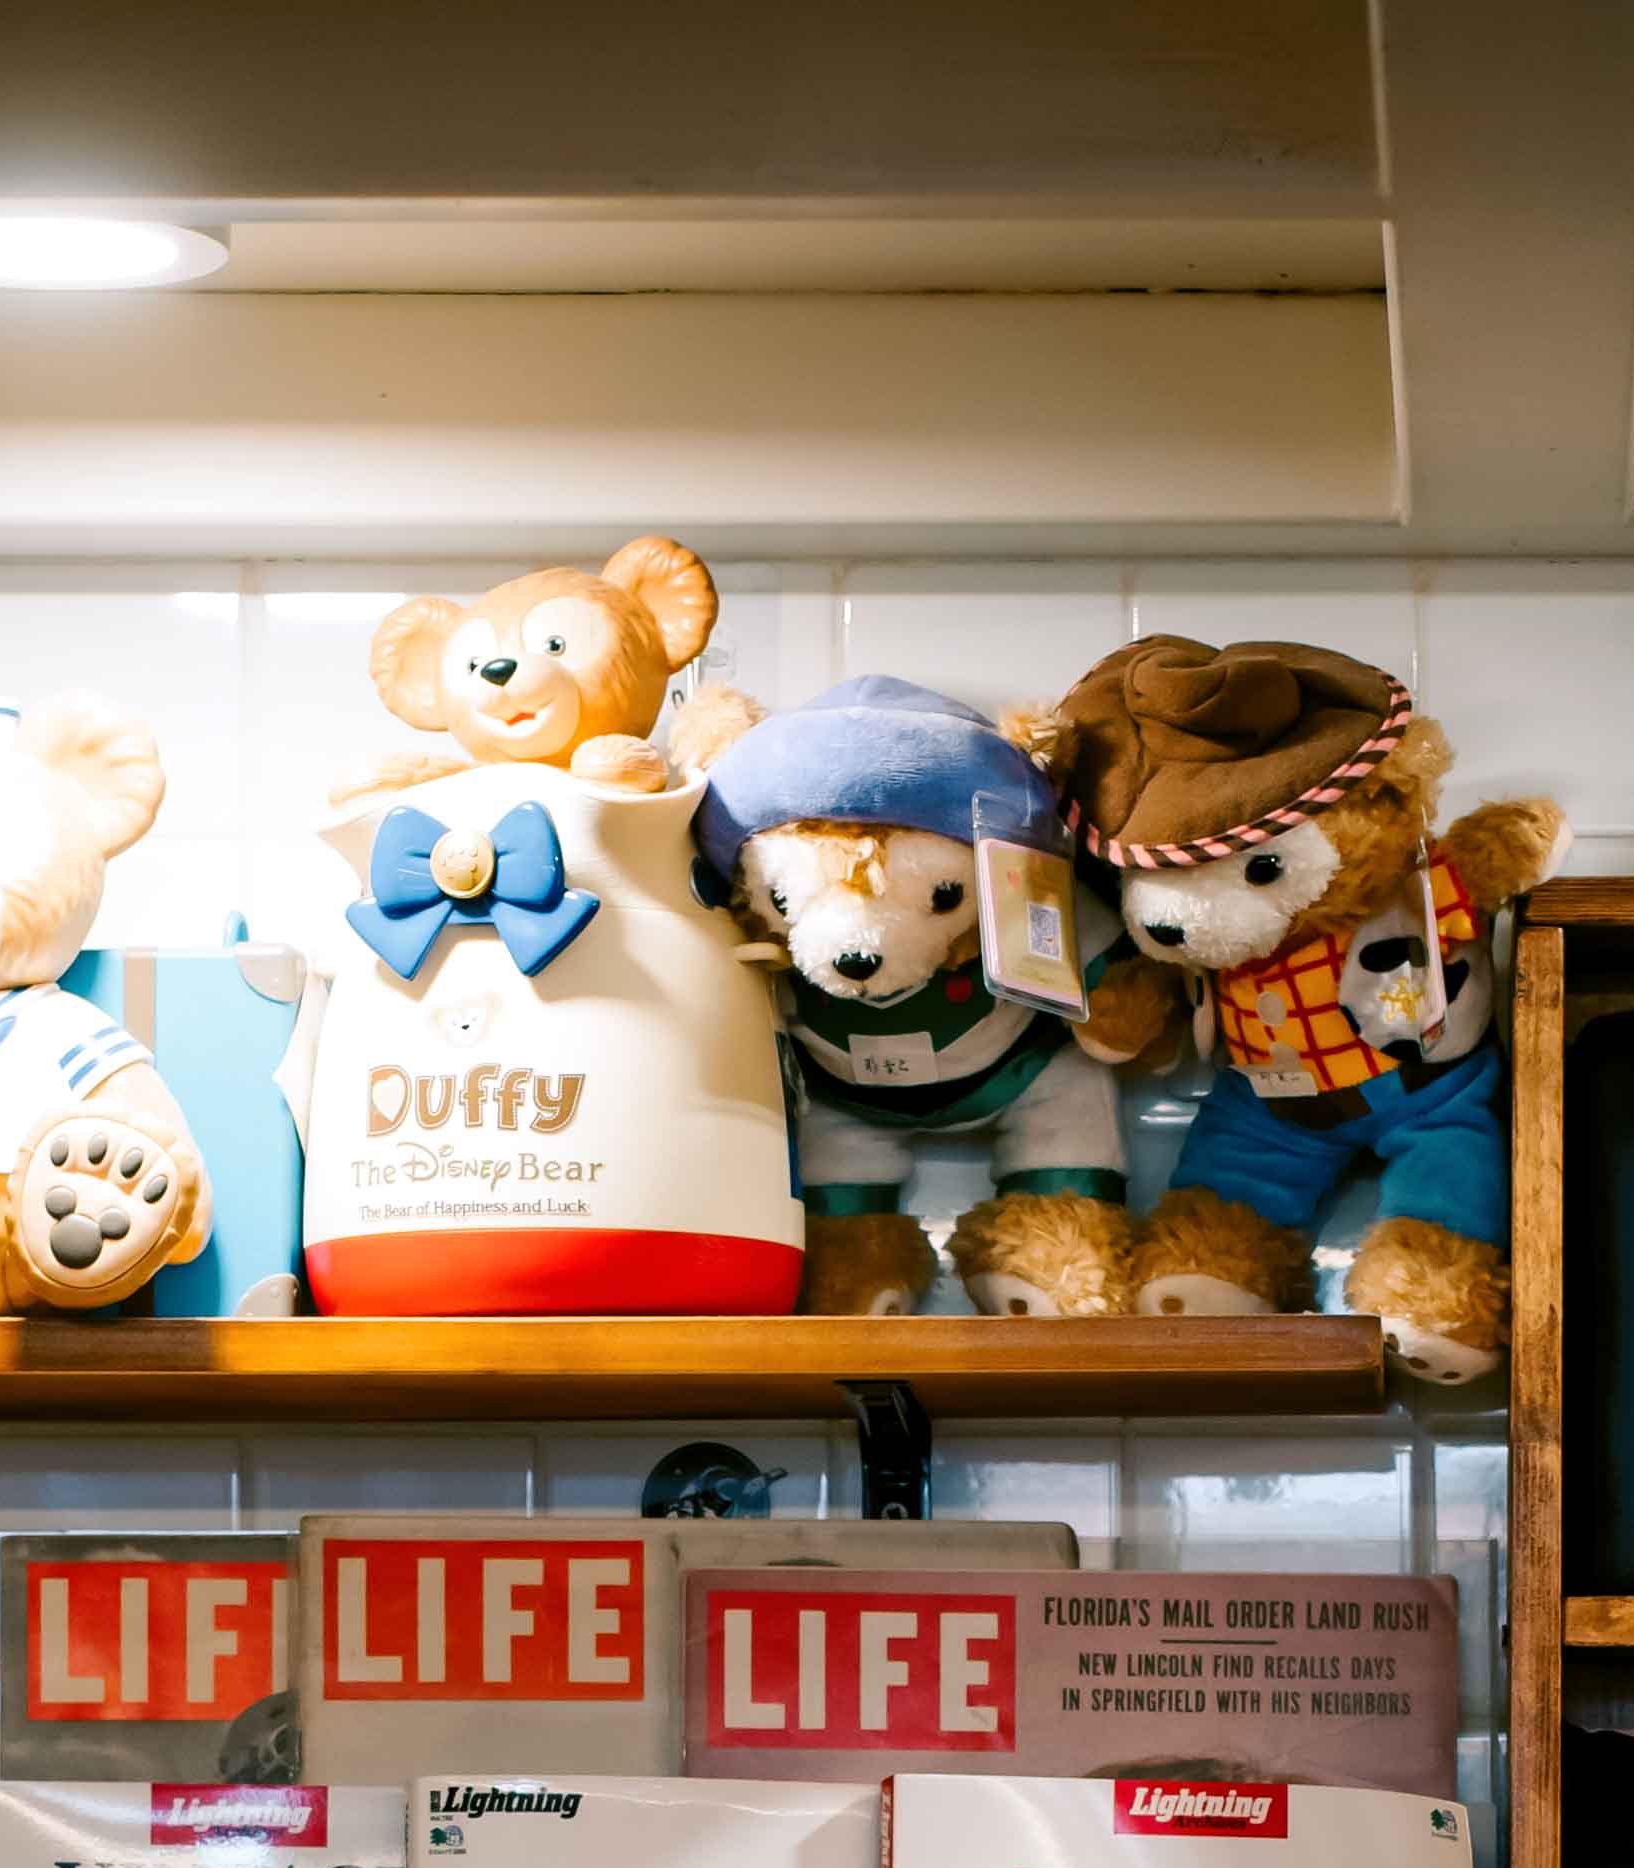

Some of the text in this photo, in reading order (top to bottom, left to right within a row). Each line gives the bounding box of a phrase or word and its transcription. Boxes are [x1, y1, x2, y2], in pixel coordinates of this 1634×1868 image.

[366, 1063, 586, 1137] Duffy
[350, 1141, 605, 1193] The Disney Bear
[359, 1197, 590, 1221] The Bear of Happiness and Luck
[338, 1558, 630, 1682] LIFE
[1043, 1596, 1429, 1632] FLORIDA'S MAIL ORDER LAND RUSH
[40, 1578, 286, 1704] LIF
[724, 1609, 999, 1733] LIFE
[1078, 1652, 1396, 1681] NEW LINCOLN FIND RECALLS DAYS
[1062, 1688, 1412, 1717] IN SPRINGFIELD WITH HIS NEIGHBORS
[442, 1786, 583, 1819] Lightning
[1129, 1786, 1273, 1824] Lightning
